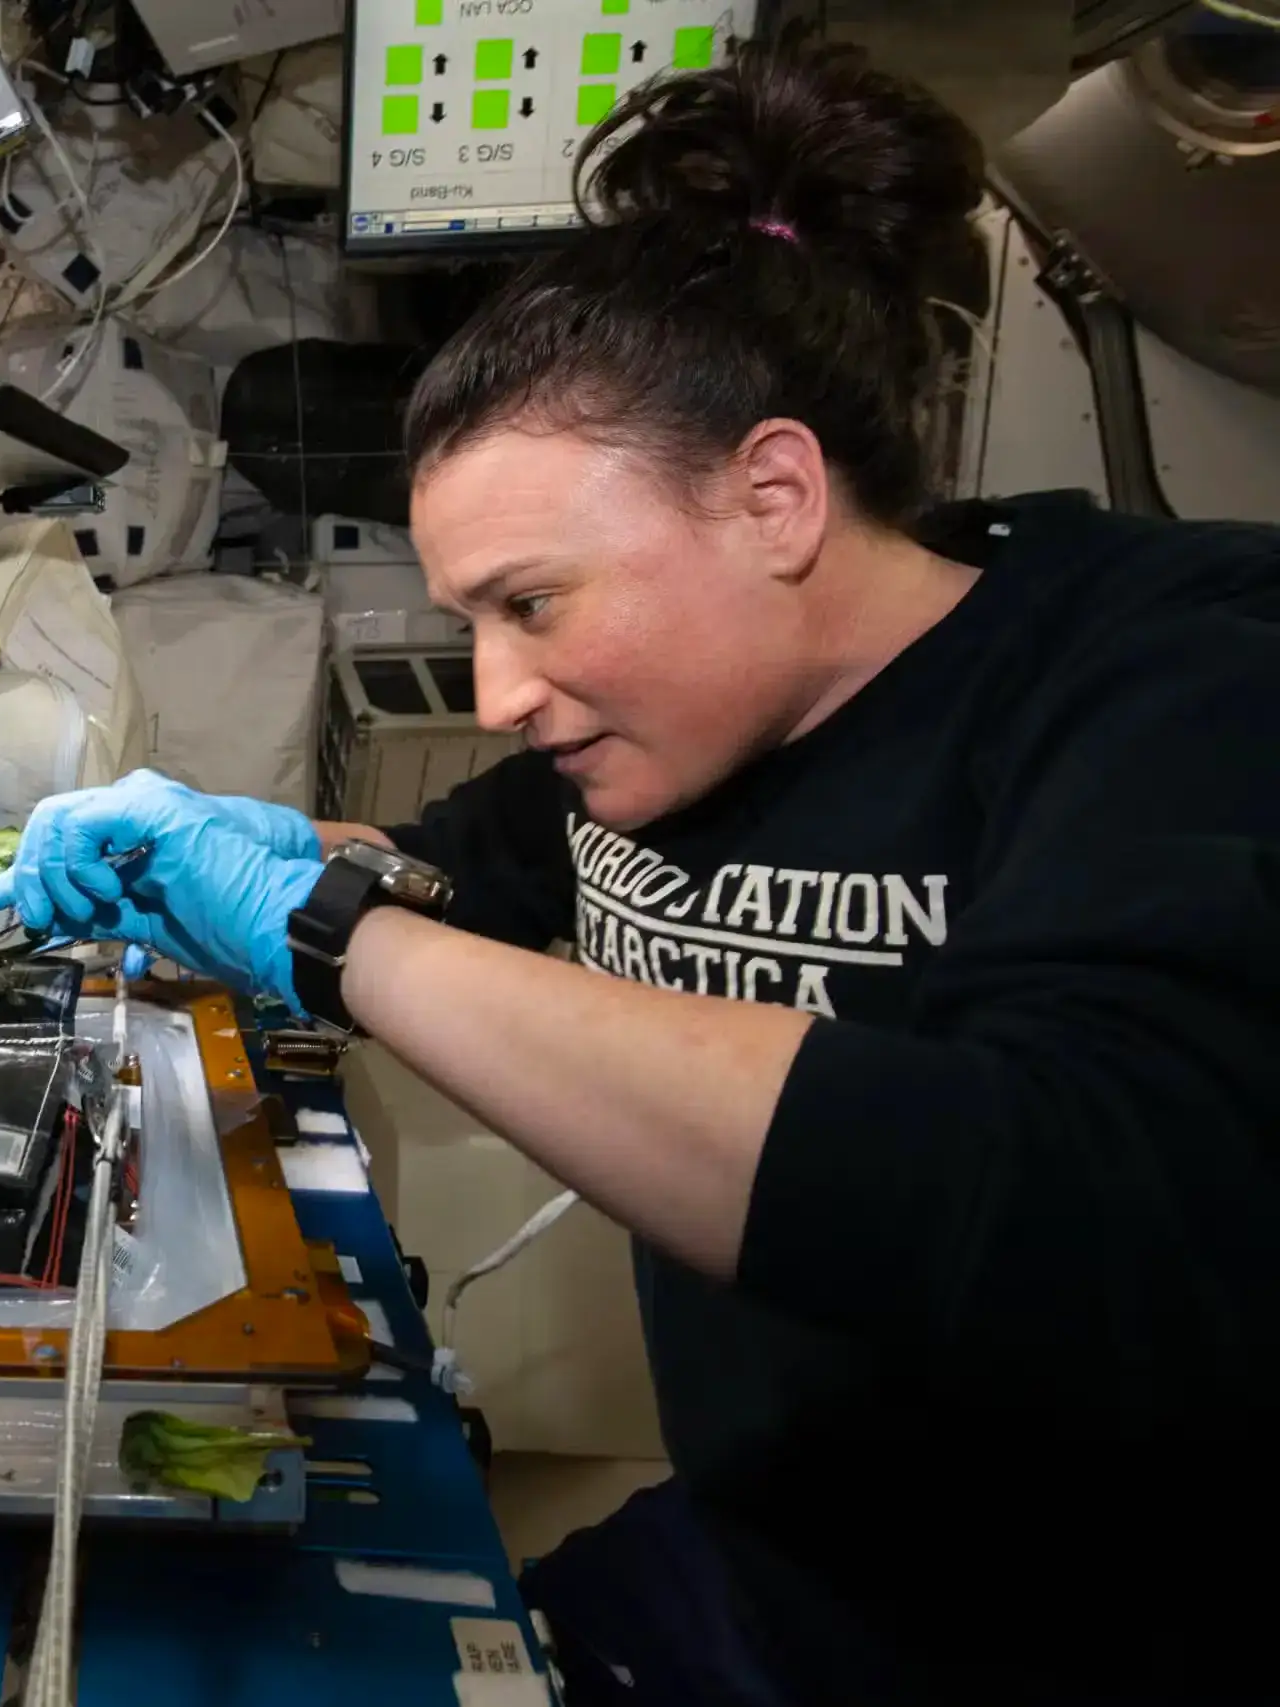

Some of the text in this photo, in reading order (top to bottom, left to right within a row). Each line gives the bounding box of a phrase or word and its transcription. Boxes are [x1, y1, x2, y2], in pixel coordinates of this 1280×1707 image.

[371, 148, 426, 168] S/G 4
[458, 143, 514, 164] S/G 3
[410, 183, 474, 201] Ku-Band
